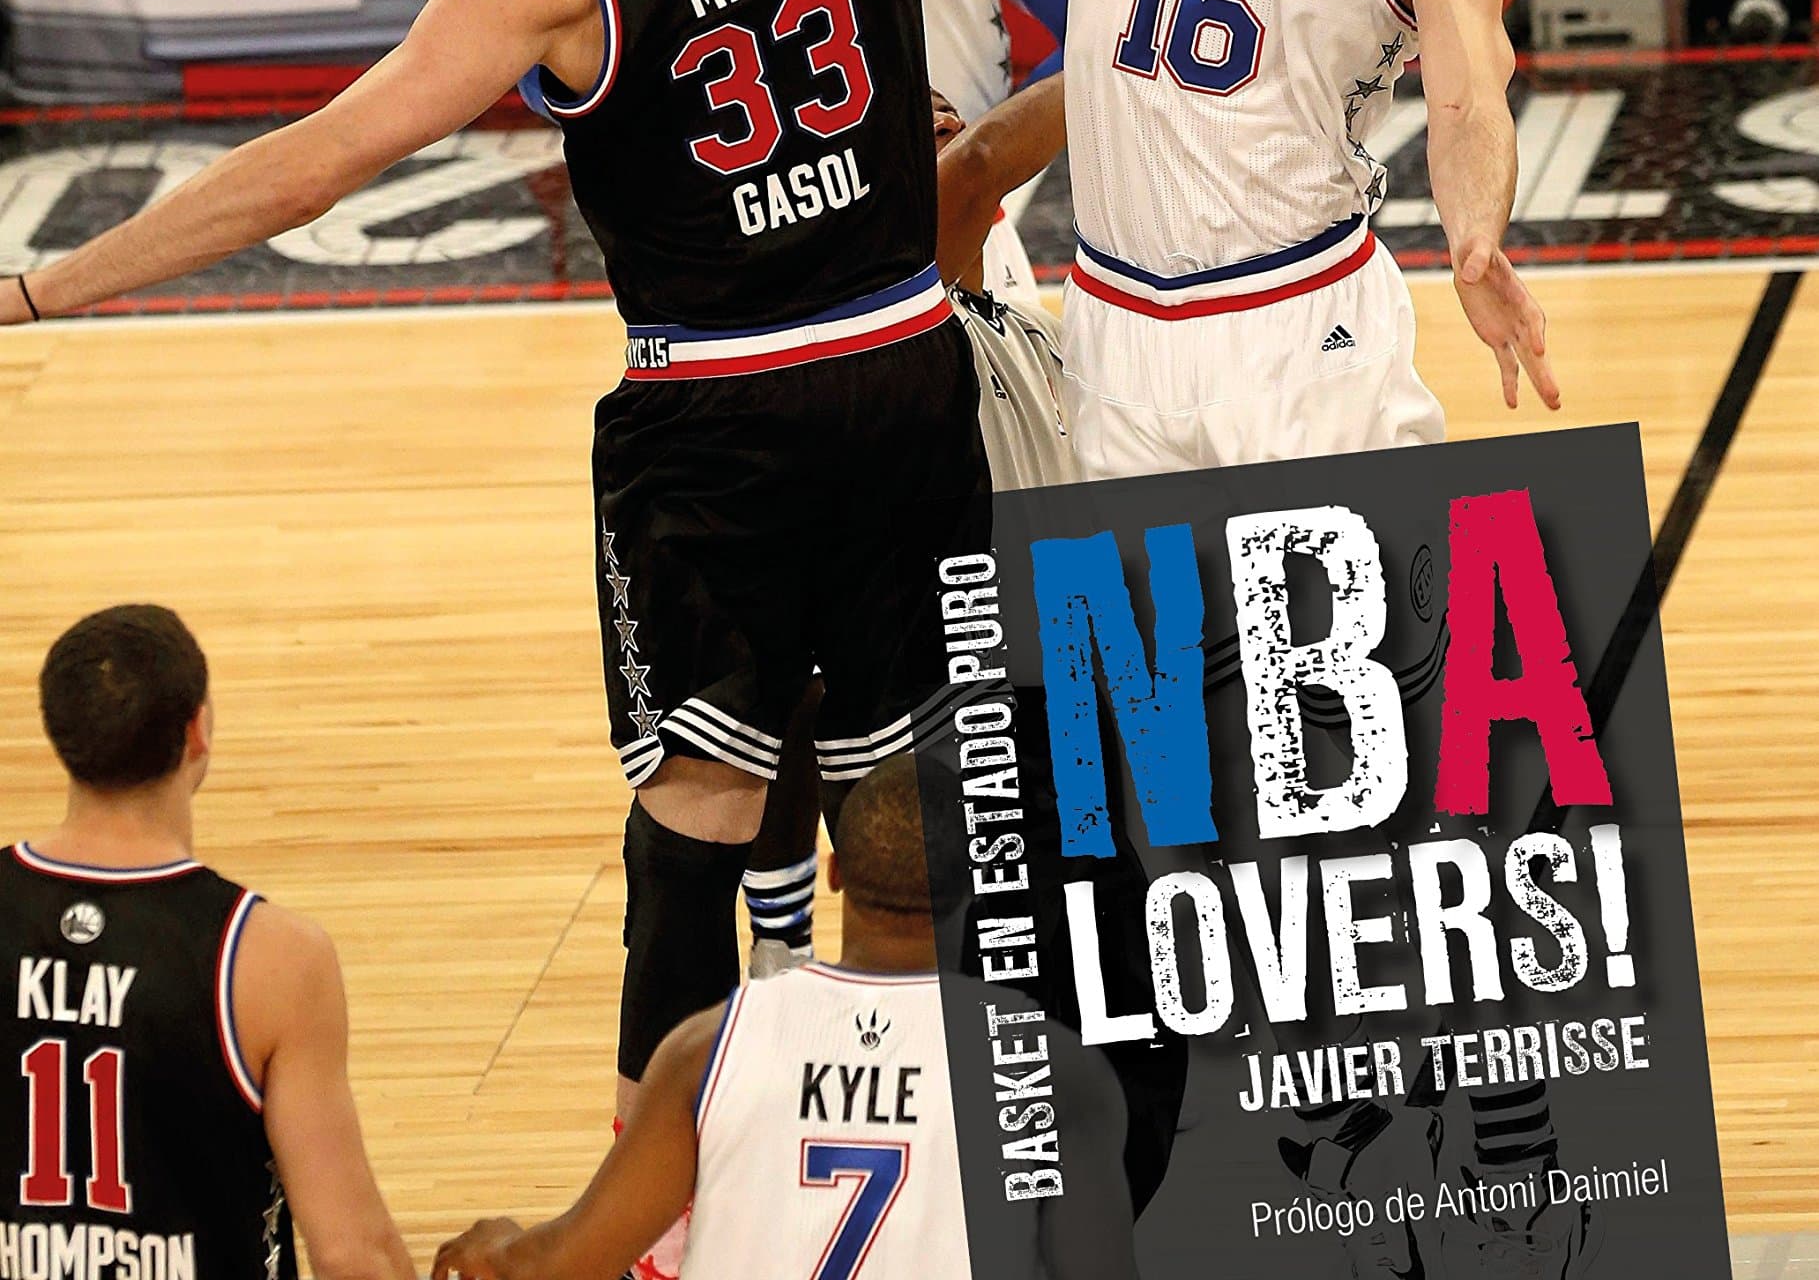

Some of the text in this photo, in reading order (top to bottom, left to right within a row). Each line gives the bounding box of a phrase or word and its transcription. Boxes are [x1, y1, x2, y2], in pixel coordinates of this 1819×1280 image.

[732, 148, 870, 237] GASOL
[17, 956, 138, 1027] KLAY
[20, 1038, 135, 1214] 11
[799, 1062, 922, 1124] KYLE
[799, 1137, 910, 1280] 7
[0, 1222, 198, 1280] HOMPSON
